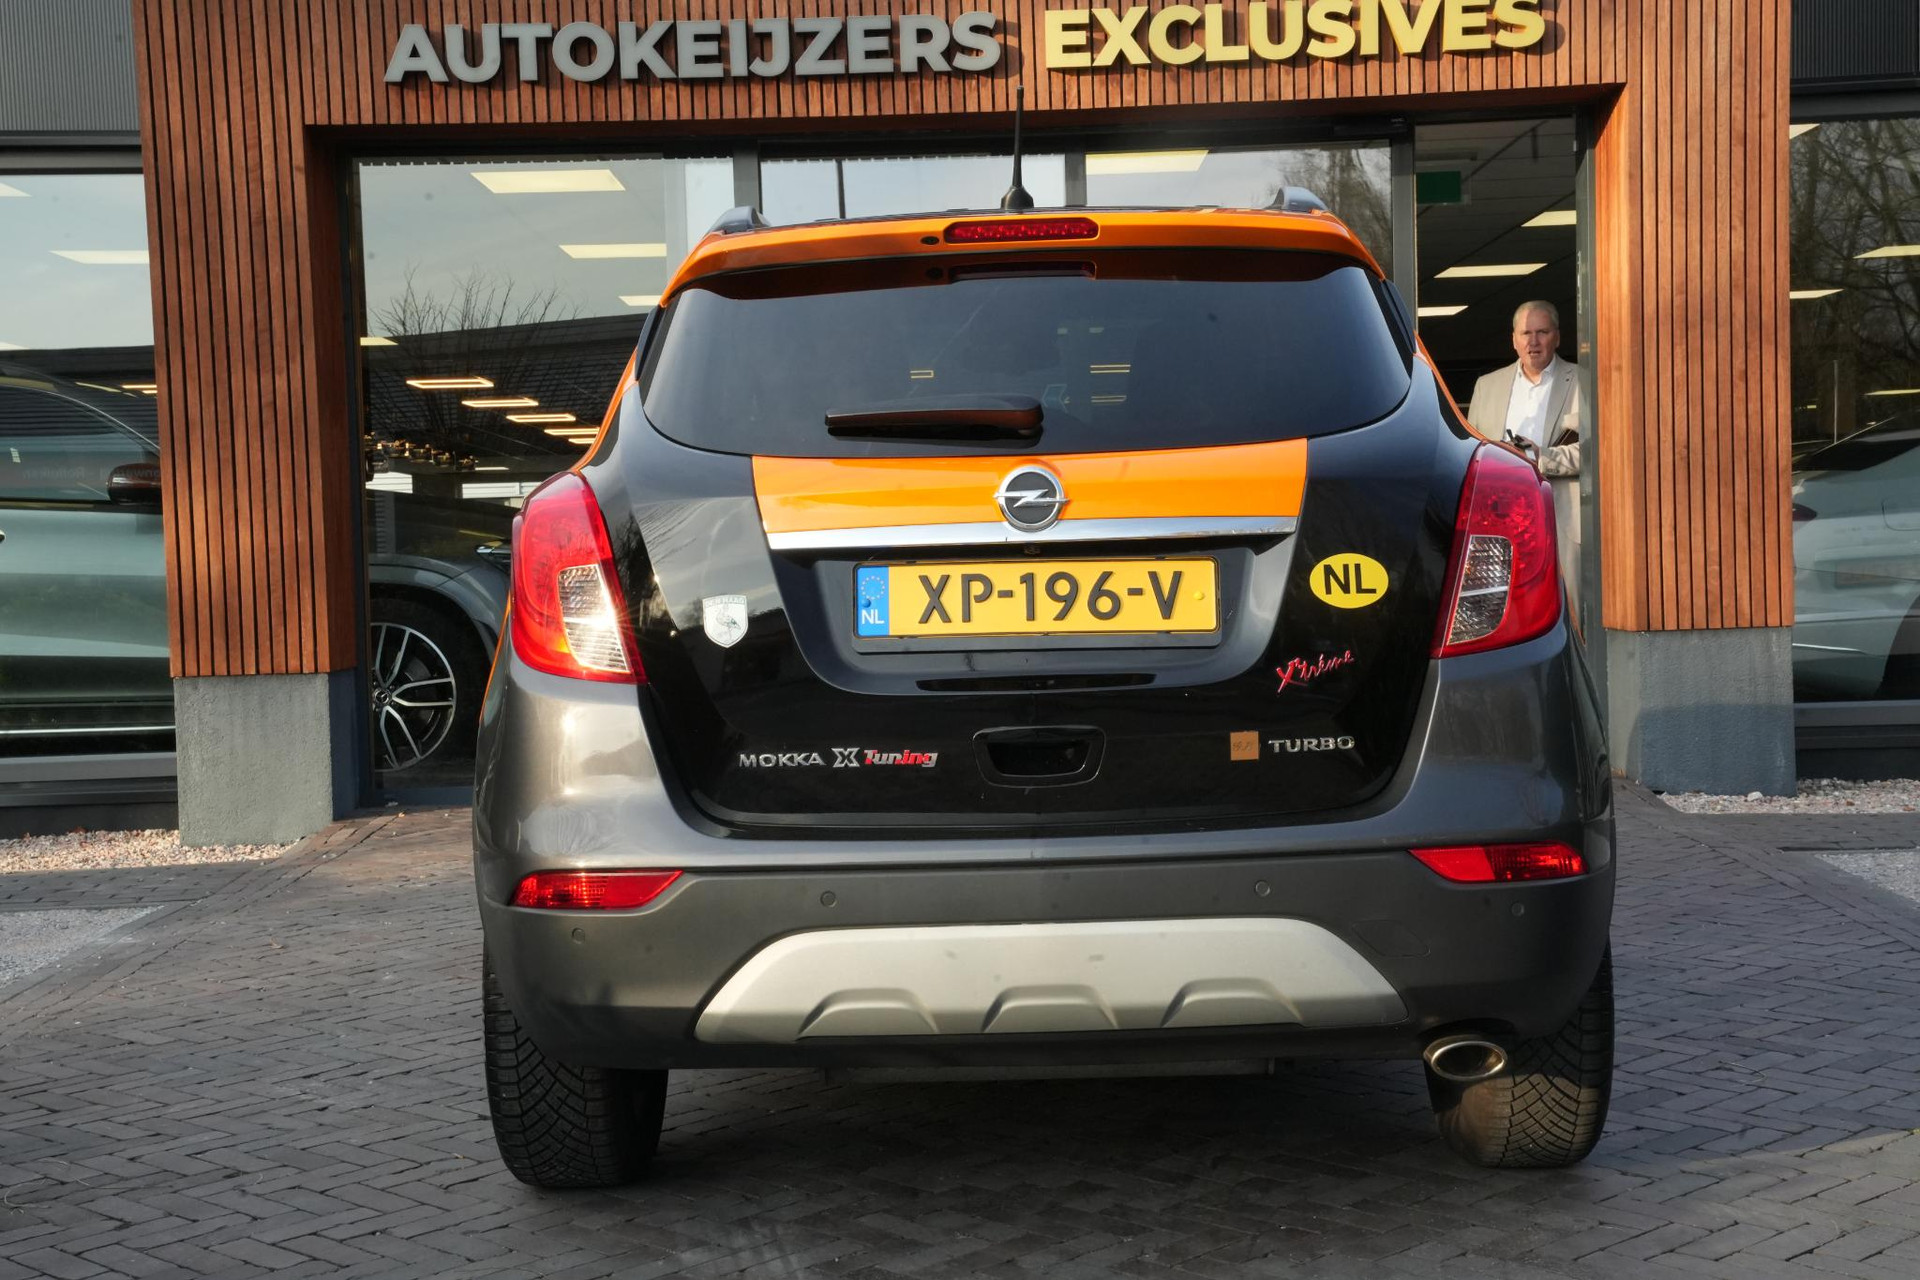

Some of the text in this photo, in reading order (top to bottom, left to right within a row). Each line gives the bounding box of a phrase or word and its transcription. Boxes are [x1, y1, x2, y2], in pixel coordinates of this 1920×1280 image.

[384, 0, 1546, 82] AUTOKEIJZERS EXCLUSIVES
[1323, 563, 1377, 595] NL
[917, 570, 1183, 624] XP-196-V
[861, 609, 885, 625] NL
[1268, 736, 1355, 753] TURBO
[739, 748, 938, 768] MOKKA X Tuning
